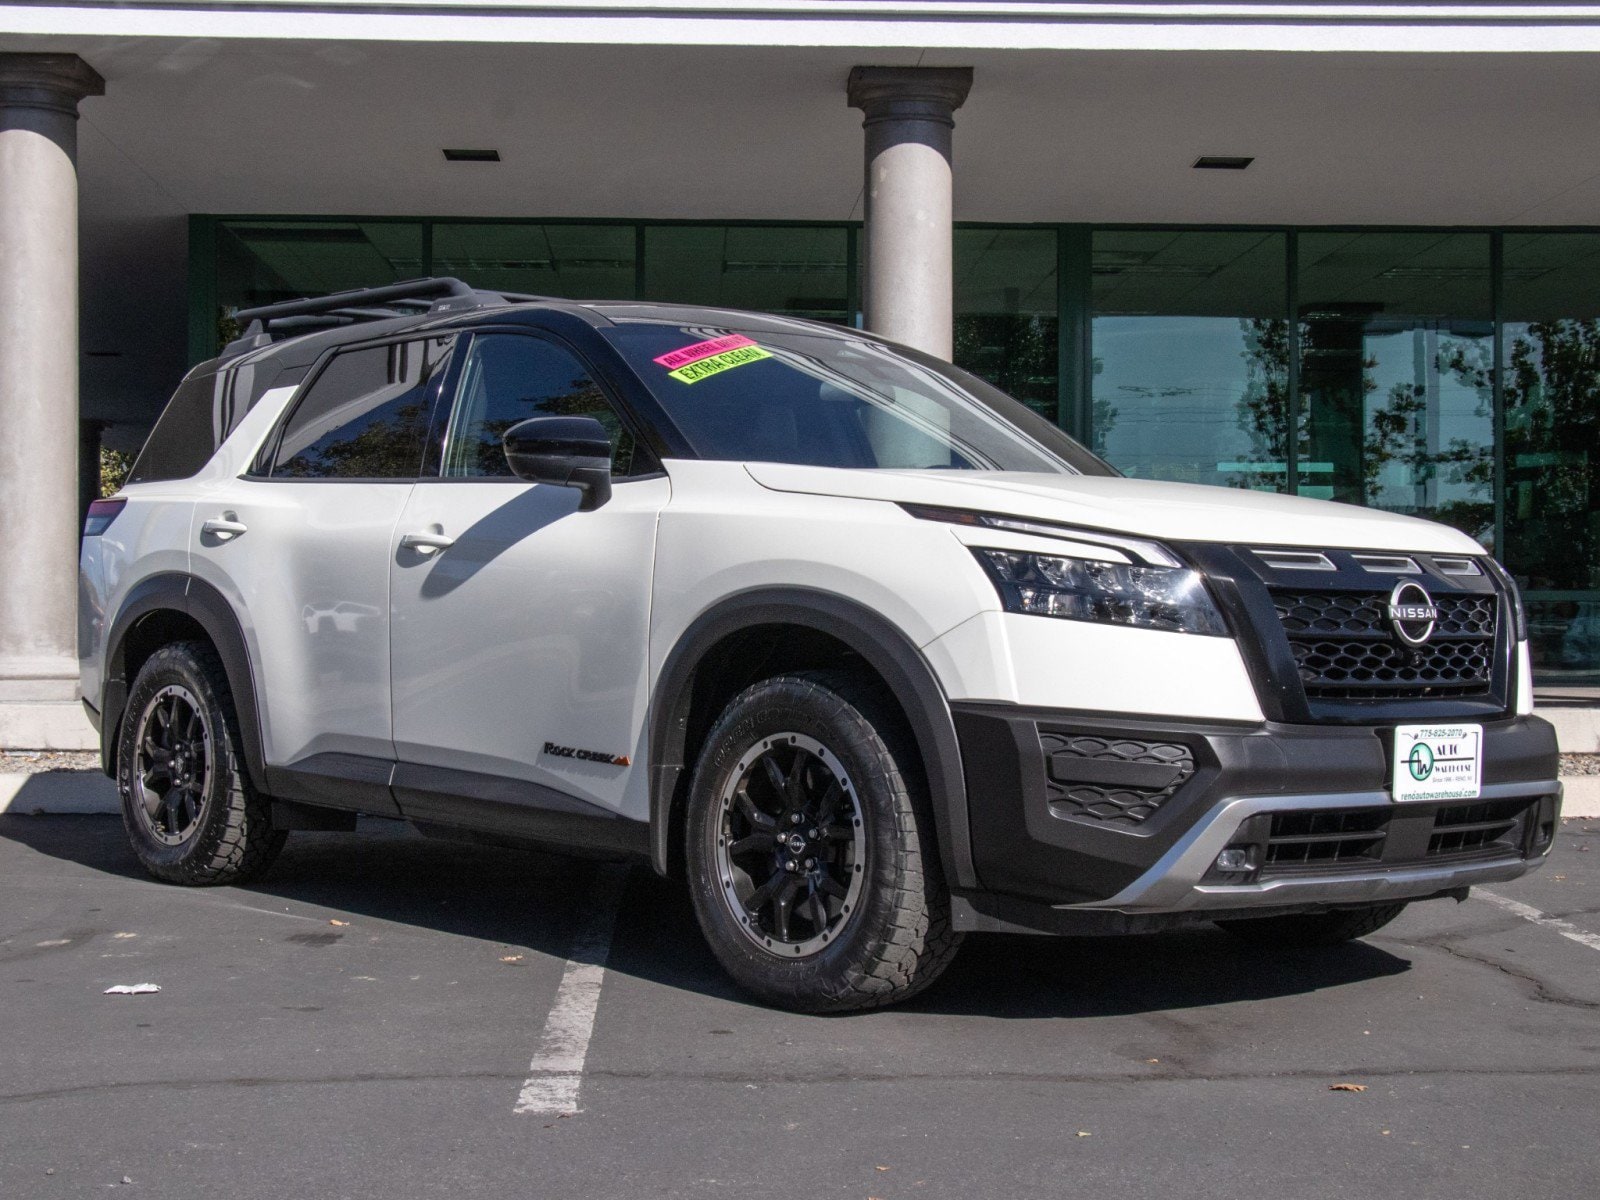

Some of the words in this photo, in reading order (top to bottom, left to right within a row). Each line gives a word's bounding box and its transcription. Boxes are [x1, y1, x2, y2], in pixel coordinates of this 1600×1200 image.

[663, 353, 691, 367] ALL
[681, 342, 719, 358] WHEEL
[678, 357, 724, 380] EXTRA
[718, 347, 763, 365] CLEAN
[1390, 607, 1438, 619] NISSAN
[1419, 728, 1464, 738] 775-825-2070
[1435, 744, 1460, 756] AUTO
[1435, 764, 1472, 773] WAREHOUSE
[1400, 789, 1478, 801] renoautowarehouse.com
